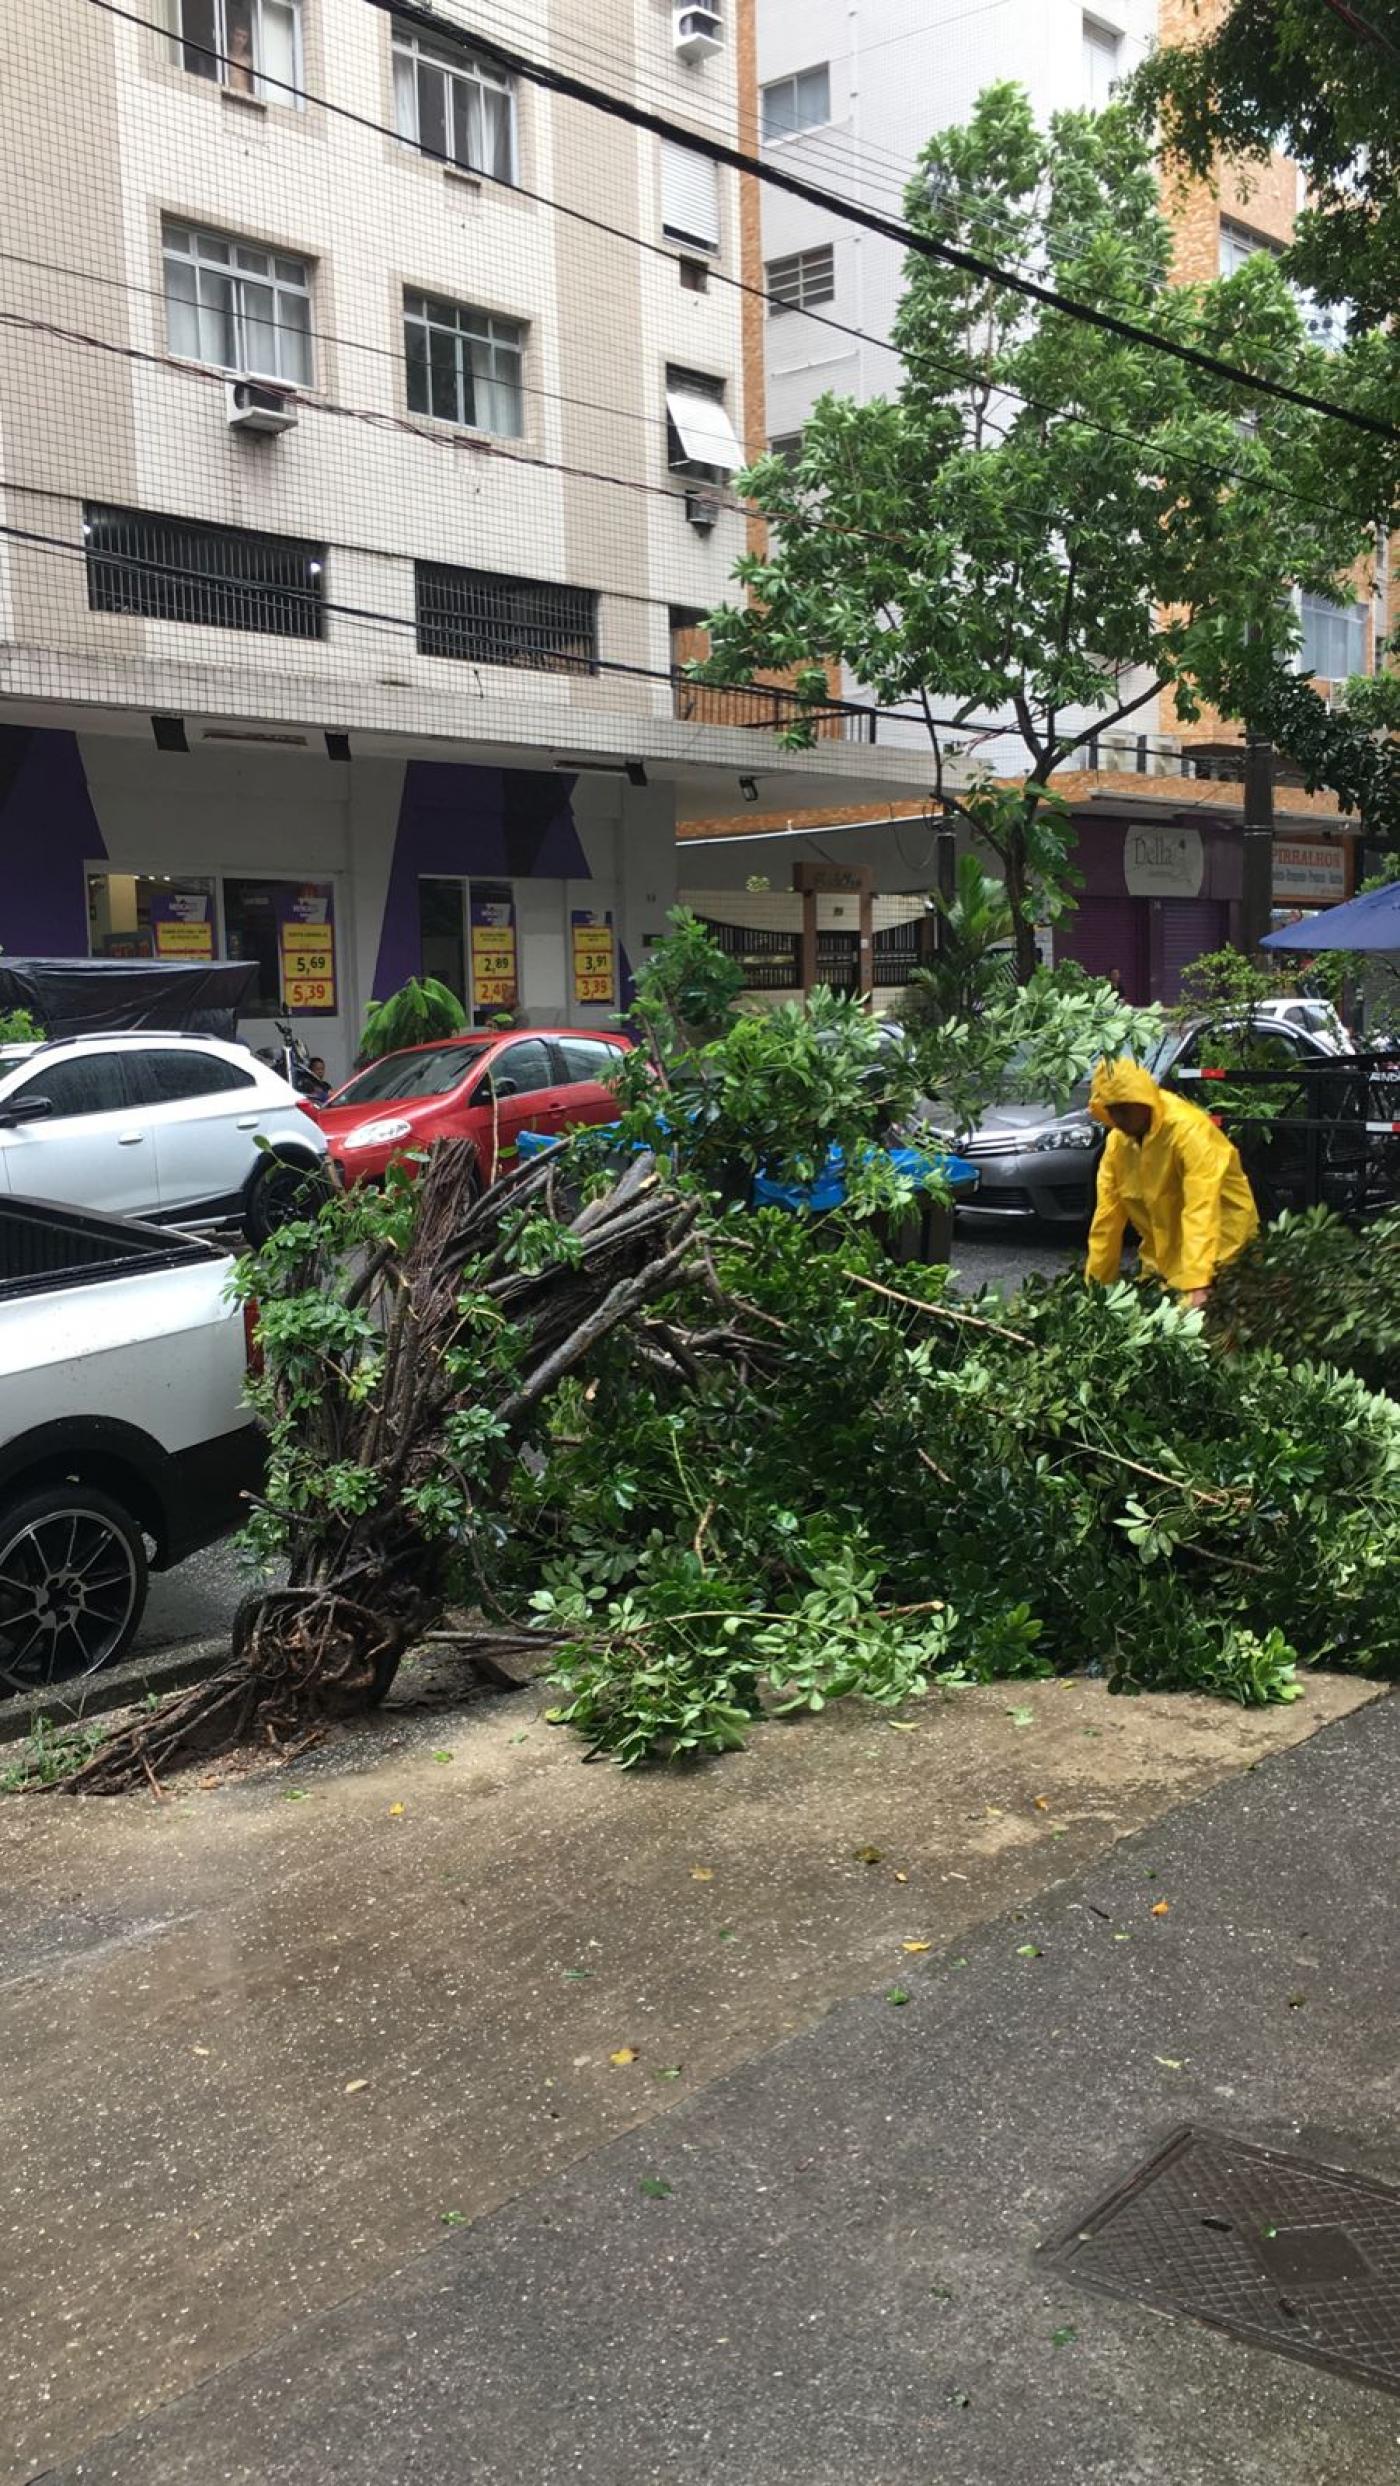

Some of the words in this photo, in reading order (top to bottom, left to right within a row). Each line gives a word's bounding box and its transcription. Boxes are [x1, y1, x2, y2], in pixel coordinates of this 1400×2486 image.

[296, 956, 326, 975] 5,69
[484, 957, 509, 974] 2,89
[292, 984, 325, 1004] 5,39
[582, 980, 607, 999] 3,39
